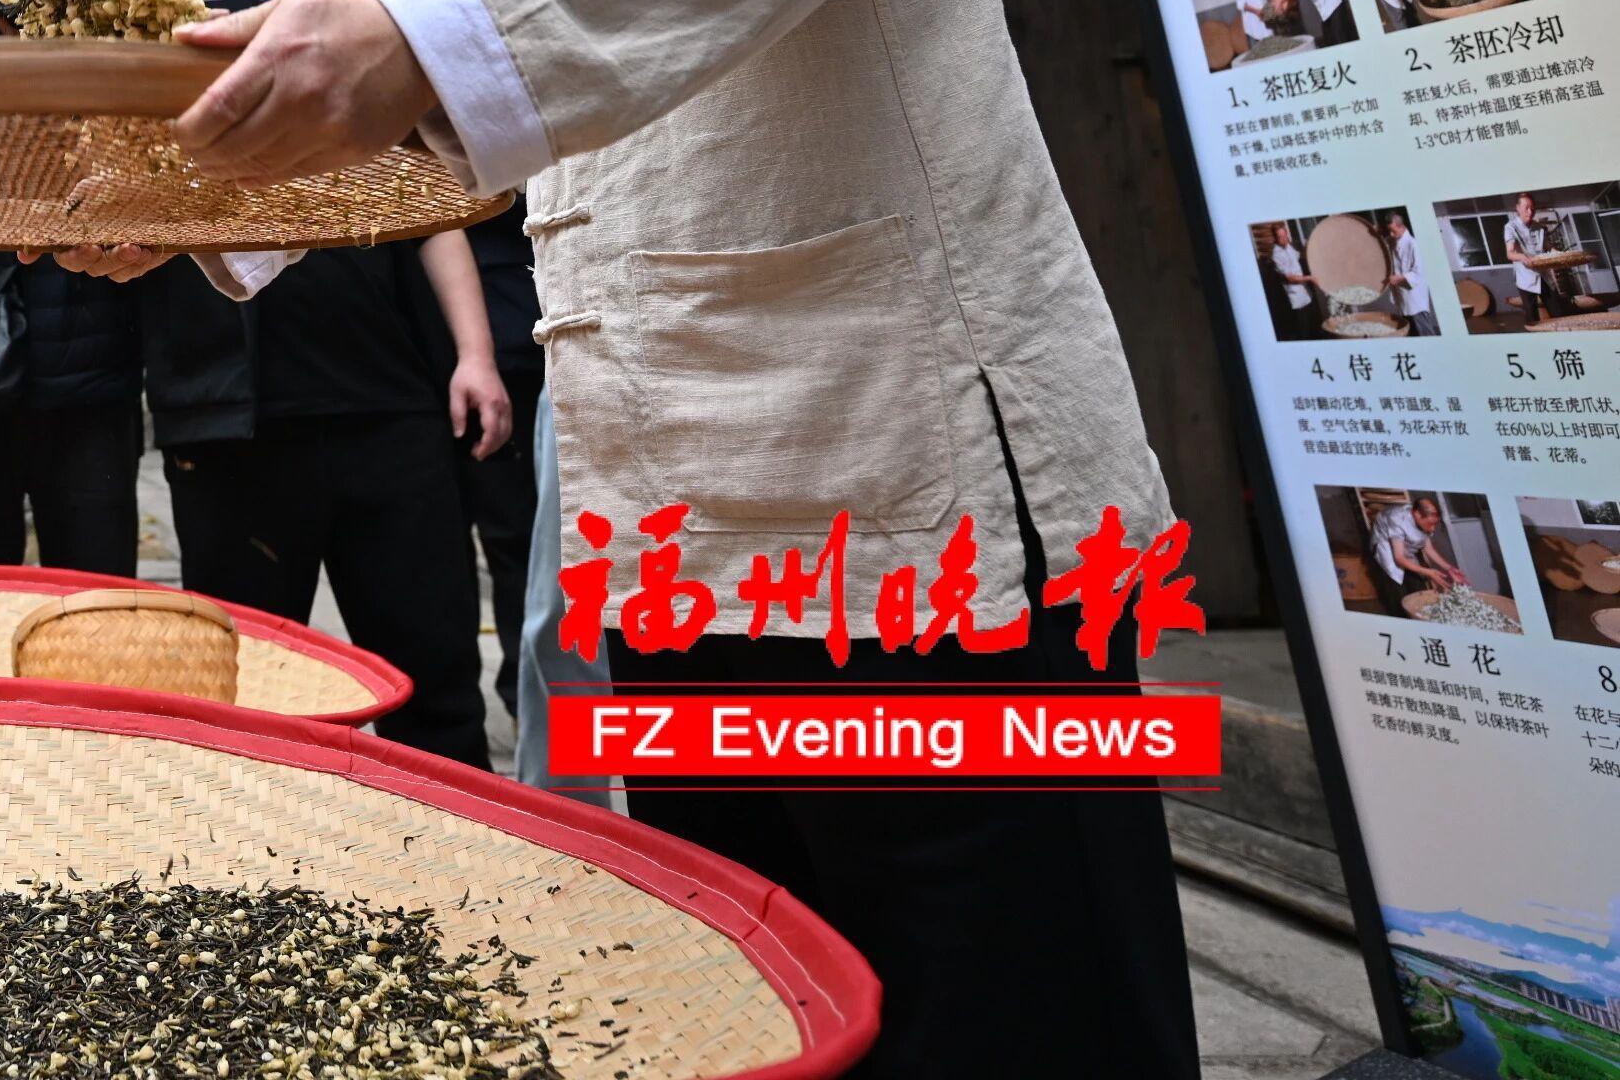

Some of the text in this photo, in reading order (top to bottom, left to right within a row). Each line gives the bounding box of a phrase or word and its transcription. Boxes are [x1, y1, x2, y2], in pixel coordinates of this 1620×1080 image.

[1405, 15, 1565, 72] 2、茶胚冷却
[1228, 60, 1357, 109] 1、茶胚复火
[1496, 421, 1620, 439] 在60%以上时即可
